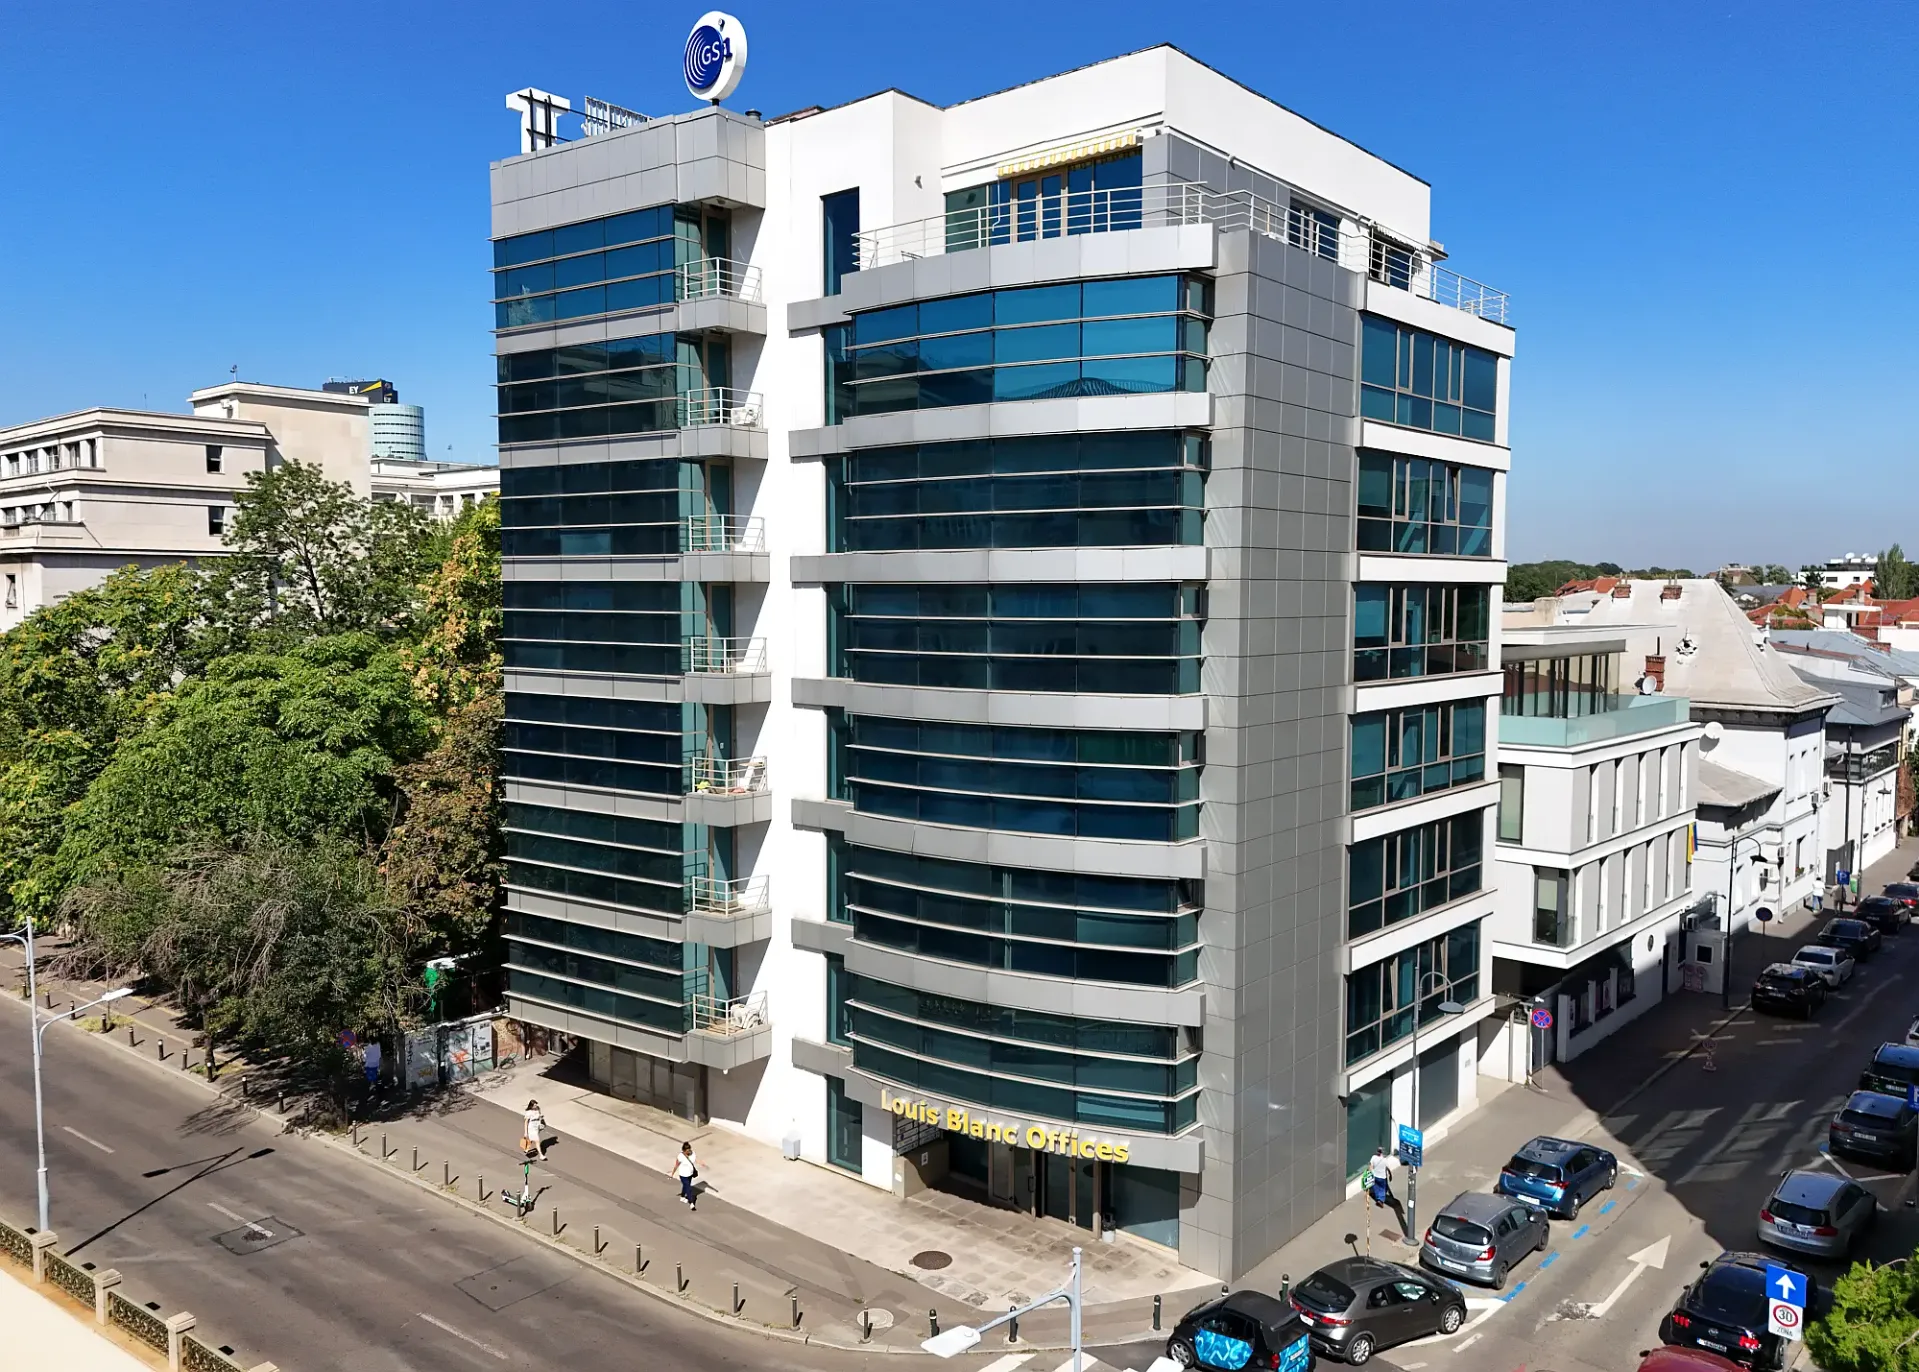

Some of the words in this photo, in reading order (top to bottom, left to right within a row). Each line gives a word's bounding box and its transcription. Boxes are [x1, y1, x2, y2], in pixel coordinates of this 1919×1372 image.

[702, 37, 733, 65] GS1
[349, 386, 359, 394] EY
[881, 1089, 939, 1125] Louis
[947, 1108, 1018, 1146] Blanc
[1026, 1126, 1129, 1163] Offices
[1778, 1308, 1793, 1323] 30
[1776, 1326, 1794, 1337] ZONA
